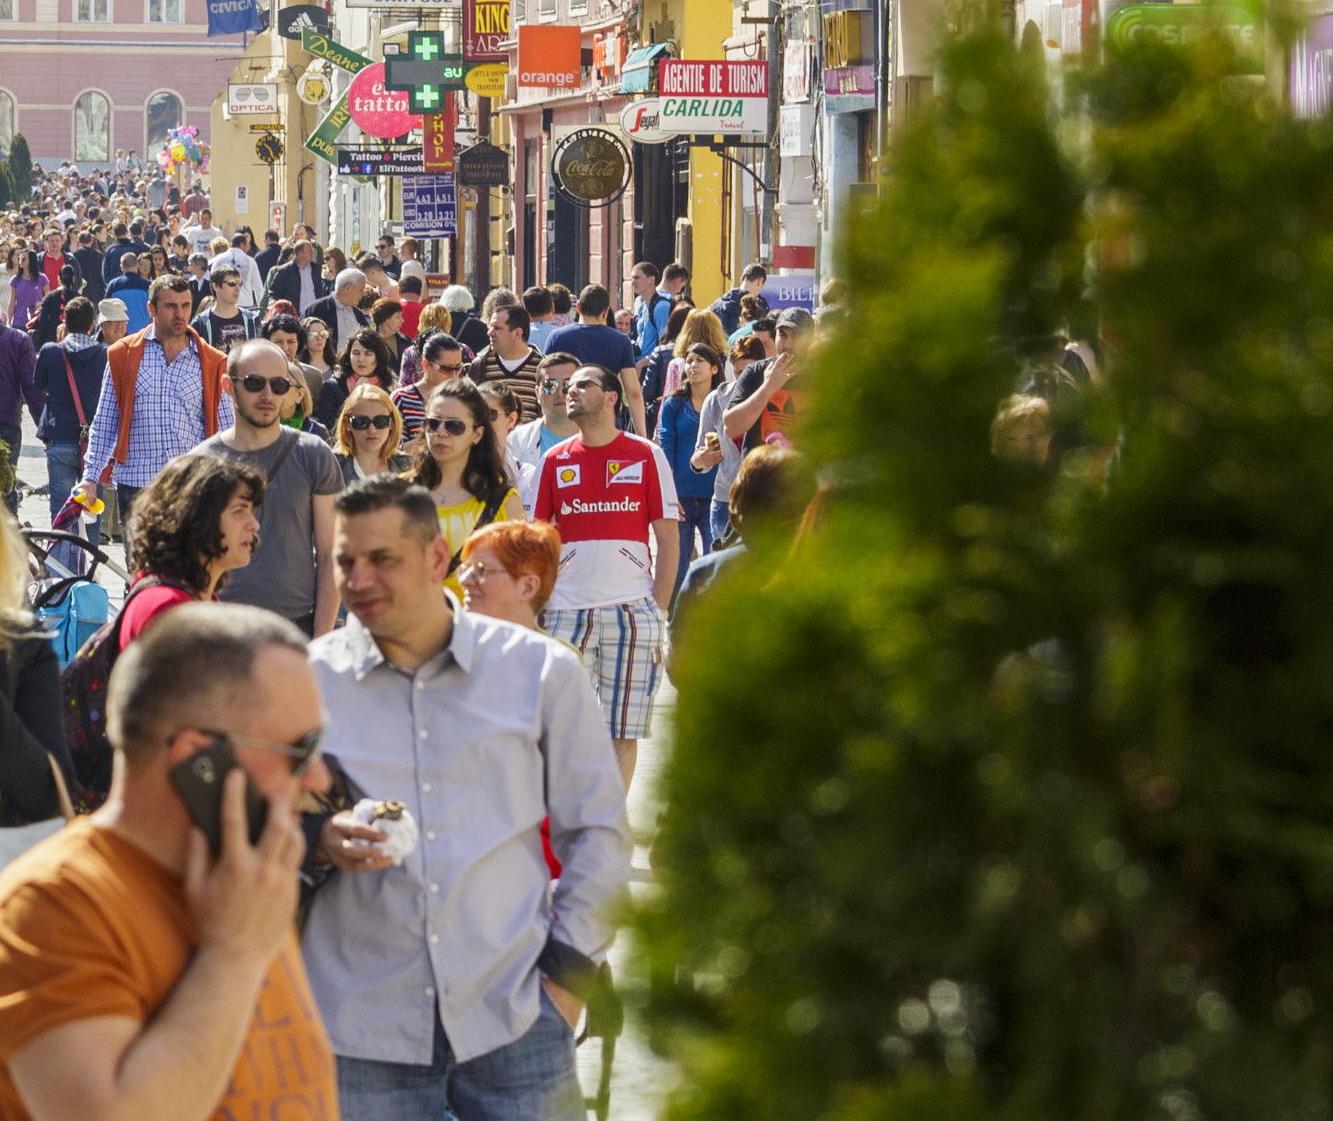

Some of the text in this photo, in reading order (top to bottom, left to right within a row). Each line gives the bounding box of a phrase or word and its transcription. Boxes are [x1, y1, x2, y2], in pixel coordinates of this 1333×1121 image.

[521, 71, 575, 86] orange
[663, 63, 705, 93] AGENTIE
[709, 64, 723, 94] DE
[728, 64, 766, 95] TURISM
[230, 104, 275, 112] OPTICA
[353, 95, 409, 112] tatto
[662, 98, 744, 118] CARLIDA
[720, 119, 746, 129] Travel
[349, 152, 382, 161] Tattoo
[404, 221, 444, 230] COMISION
[572, 495, 641, 514] Santander
